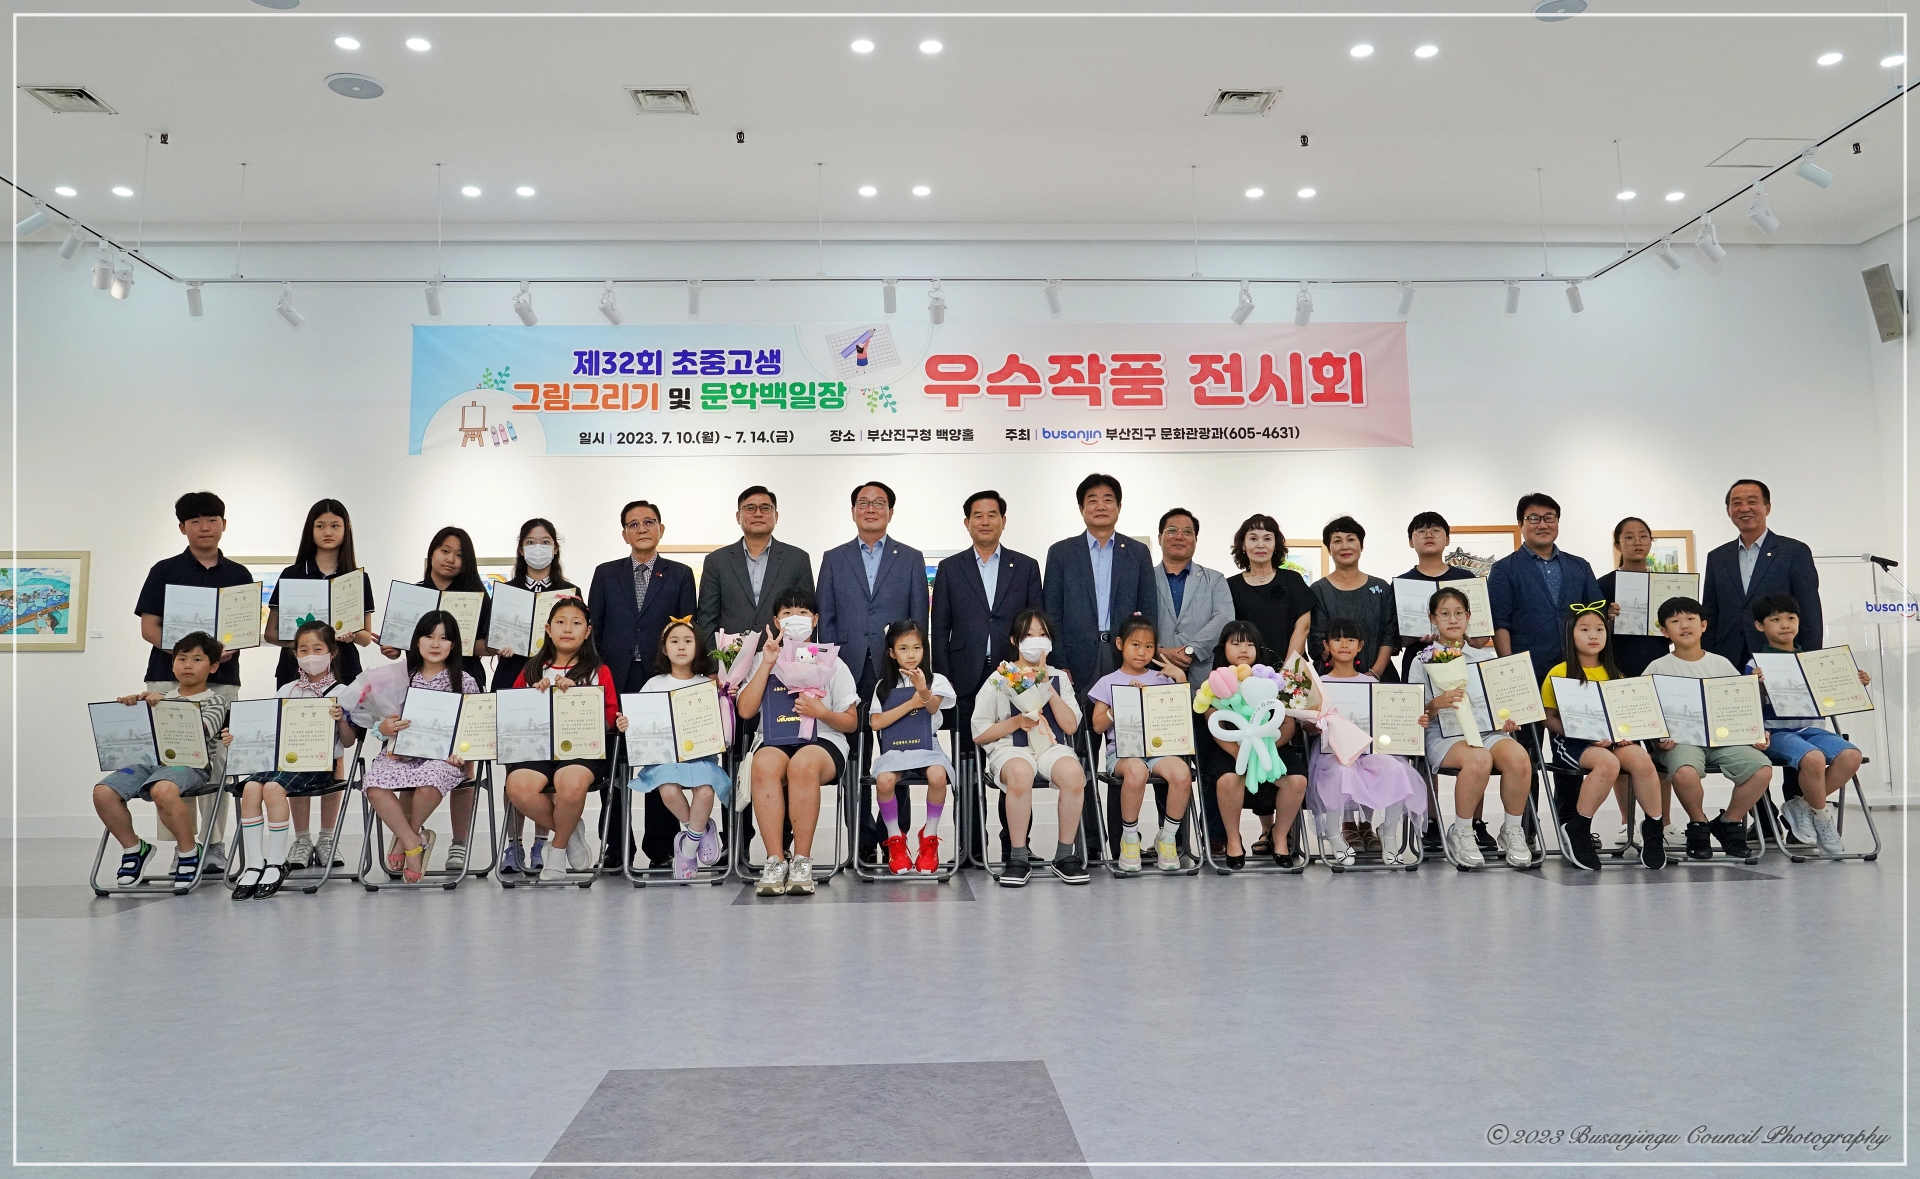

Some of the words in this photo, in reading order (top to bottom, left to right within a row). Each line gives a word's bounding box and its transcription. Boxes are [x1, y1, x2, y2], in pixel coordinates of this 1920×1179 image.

[573, 349, 662, 376] 제32회
[672, 349, 781, 375] 초중고생
[923, 353, 1165, 407] 우수작품
[1189, 351, 1364, 406] 전시회
[512, 383, 659, 411] 그림그리기
[668, 387, 691, 410] 및
[700, 381, 847, 410] 문학백일장
[579, 431, 605, 445] 일시
[616, 431, 658, 445] 2023.
[829, 429, 856, 443] 장소
[867, 428, 932, 442] 부산진구청
[936, 428, 975, 442] 백양홀
[1005, 428, 1031, 442] 주최
[1041, 427, 1102, 442] busanjin
[1105, 427, 1157, 441] 부산진구
[1160, 425, 1300, 440] 문화관광과(605-4631)
[1865, 601, 1919, 614] busanin
